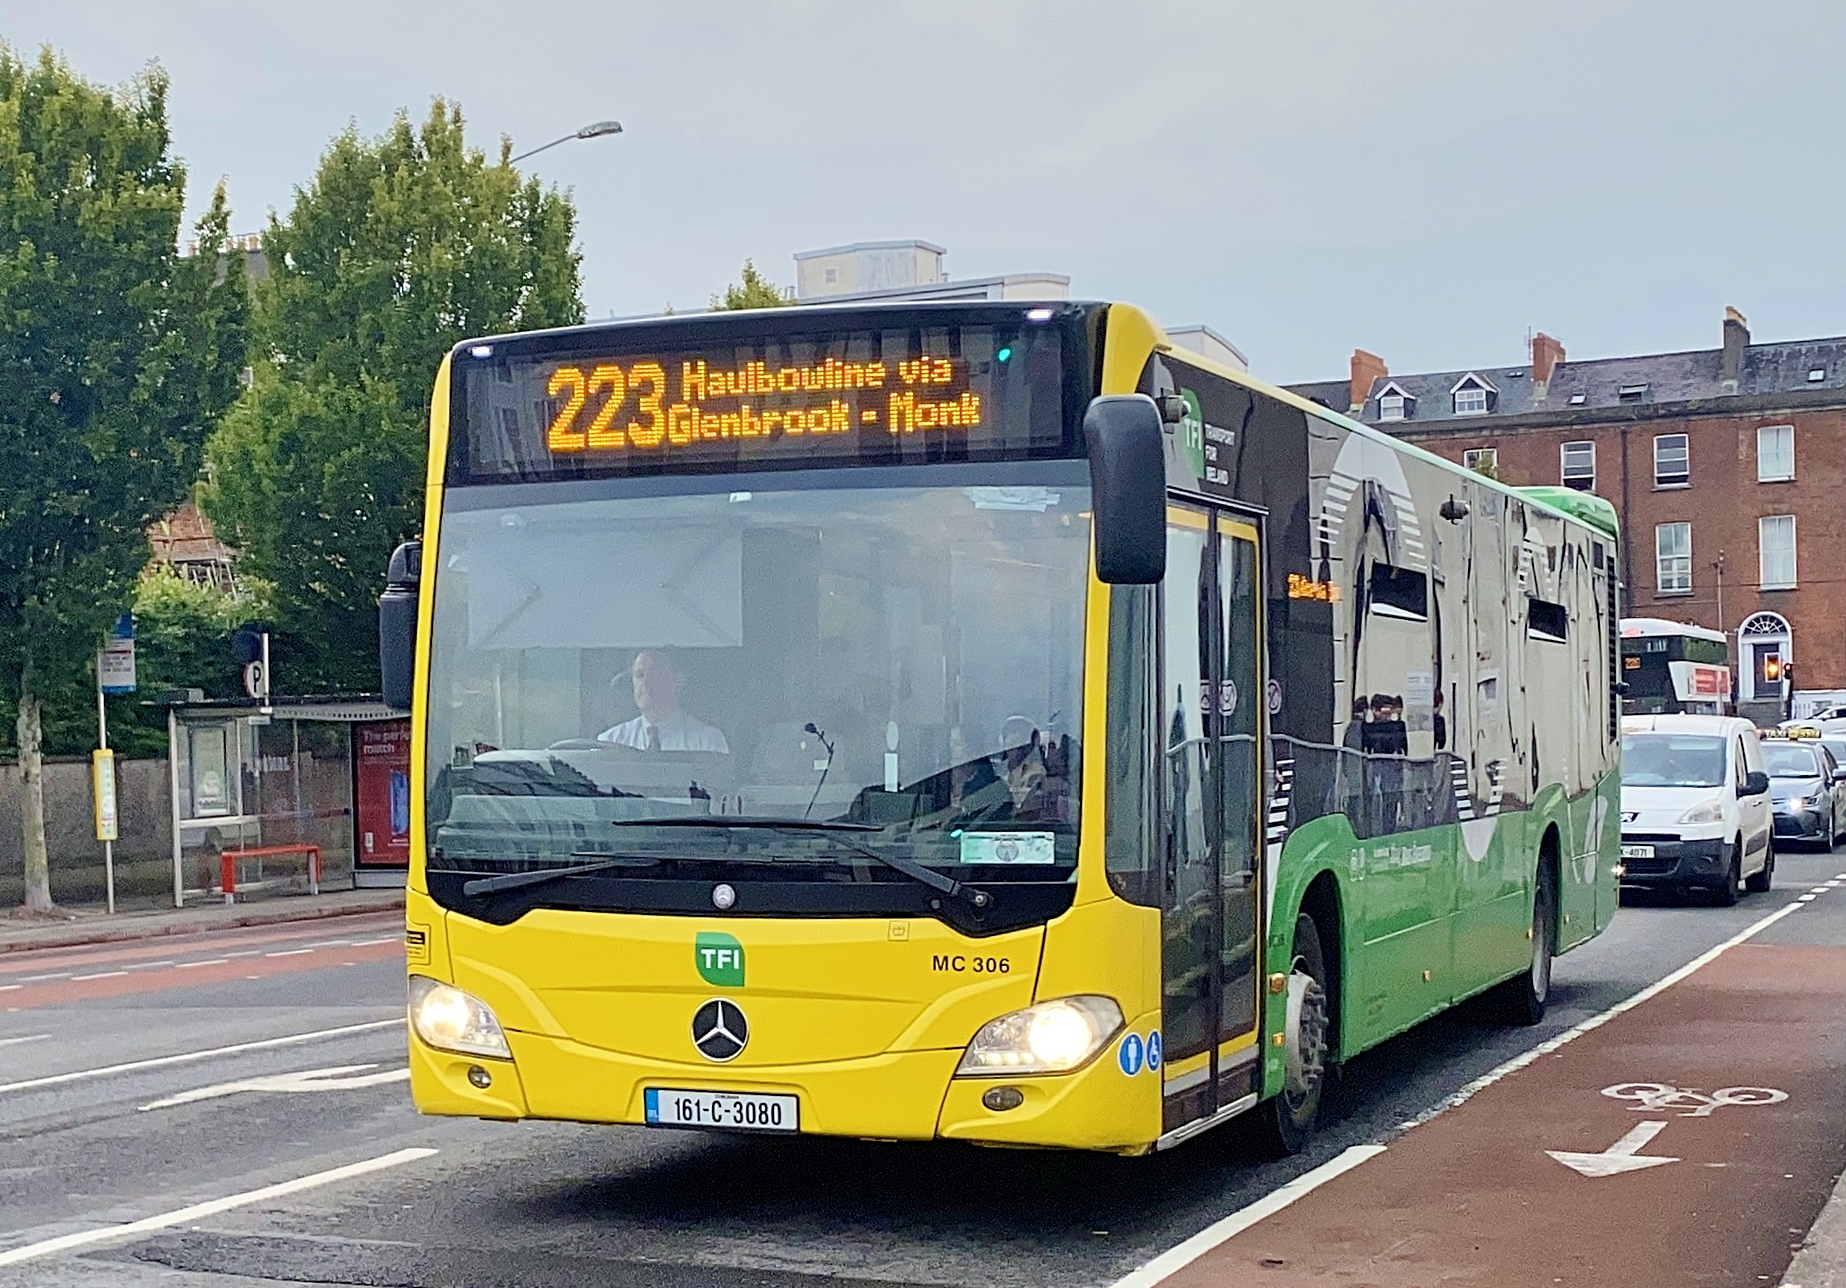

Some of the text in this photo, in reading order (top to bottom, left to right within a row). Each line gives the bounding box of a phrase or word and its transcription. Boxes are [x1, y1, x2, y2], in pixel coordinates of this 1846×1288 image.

[682, 355, 951, 400] Haulbowline via
[549, 363, 665, 448] 223
[668, 400, 849, 443] Glenbrook
[889, 391, 980, 432] Monk
[1184, 417, 1202, 450] TFI
[1764, 729, 1788, 738] TAXI
[700, 948, 740, 970] TFI
[933, 955, 1010, 973] MC 306
[674, 1097, 782, 1126] 161-C-3080
